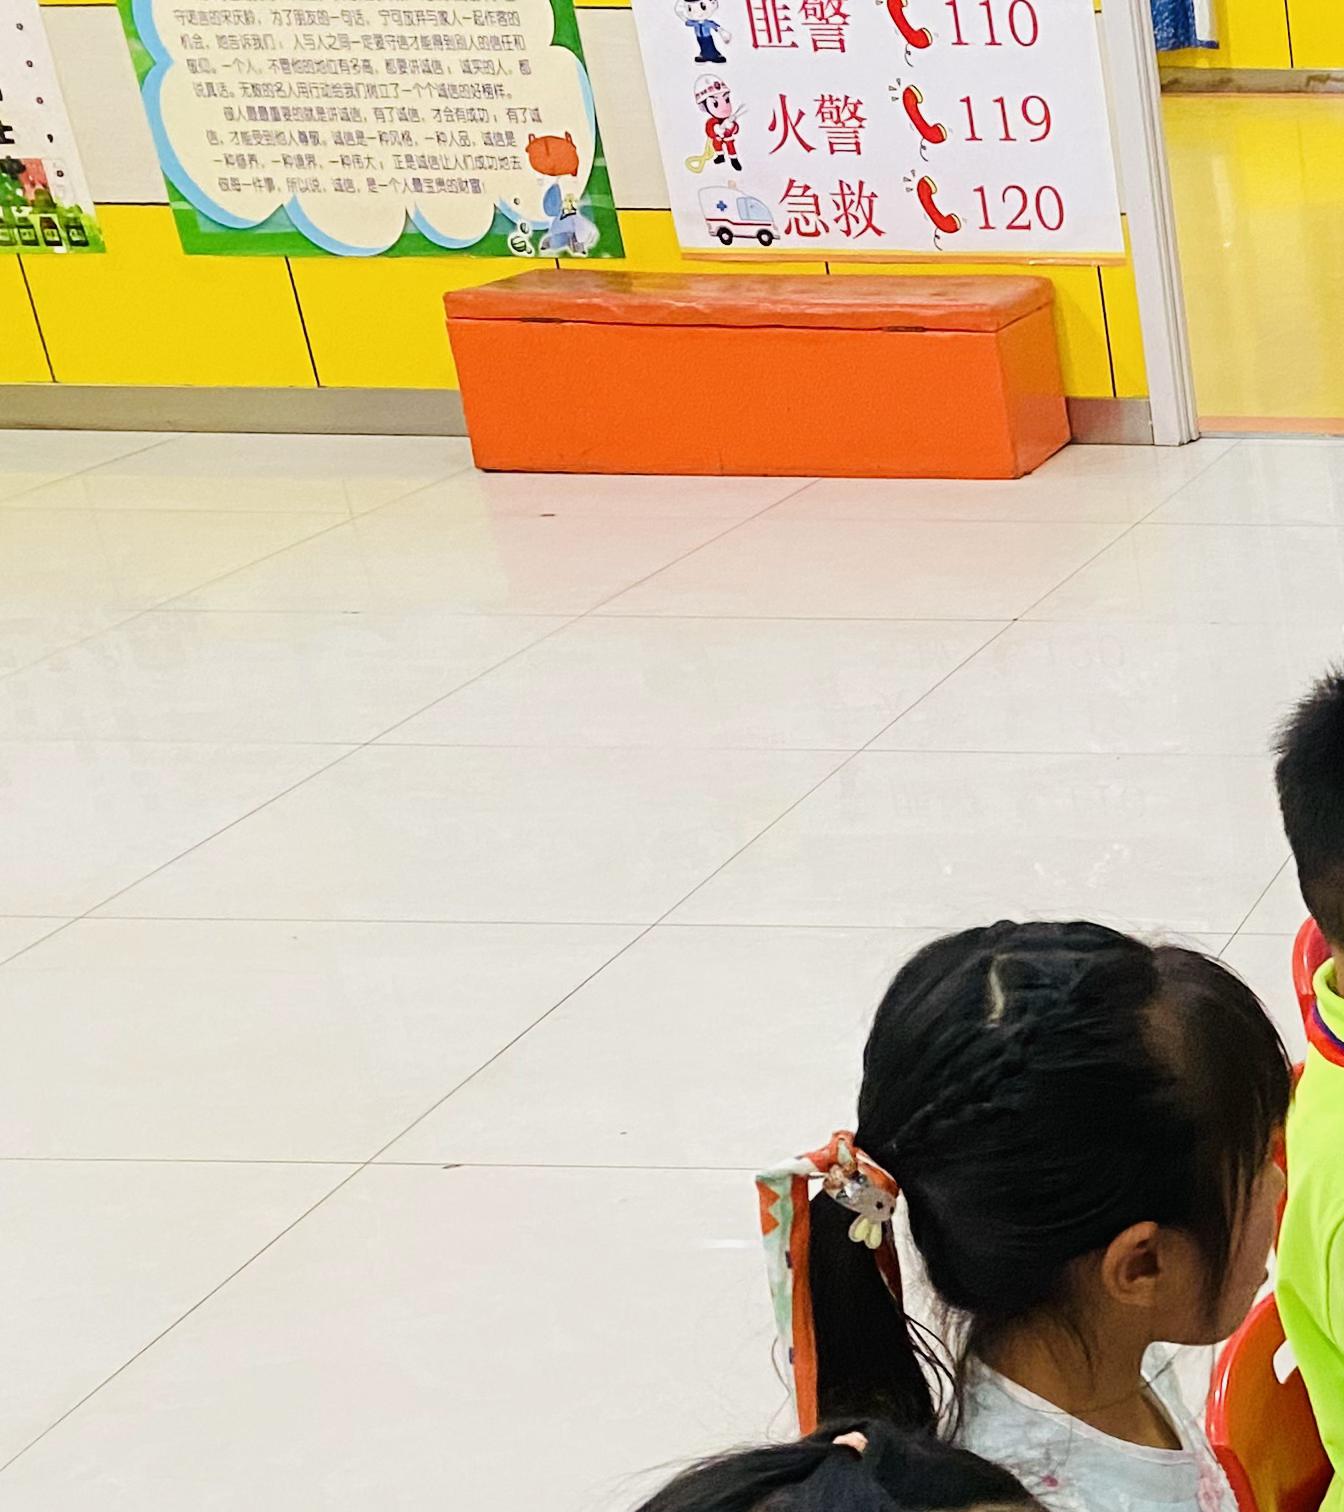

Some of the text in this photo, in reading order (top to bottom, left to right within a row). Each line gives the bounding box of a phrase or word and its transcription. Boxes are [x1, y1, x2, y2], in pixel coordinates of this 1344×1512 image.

[946, 0, 1038, 47] 110
[768, 94, 1052, 156] 火警 119
[778, 177, 1065, 239] 急救 120
